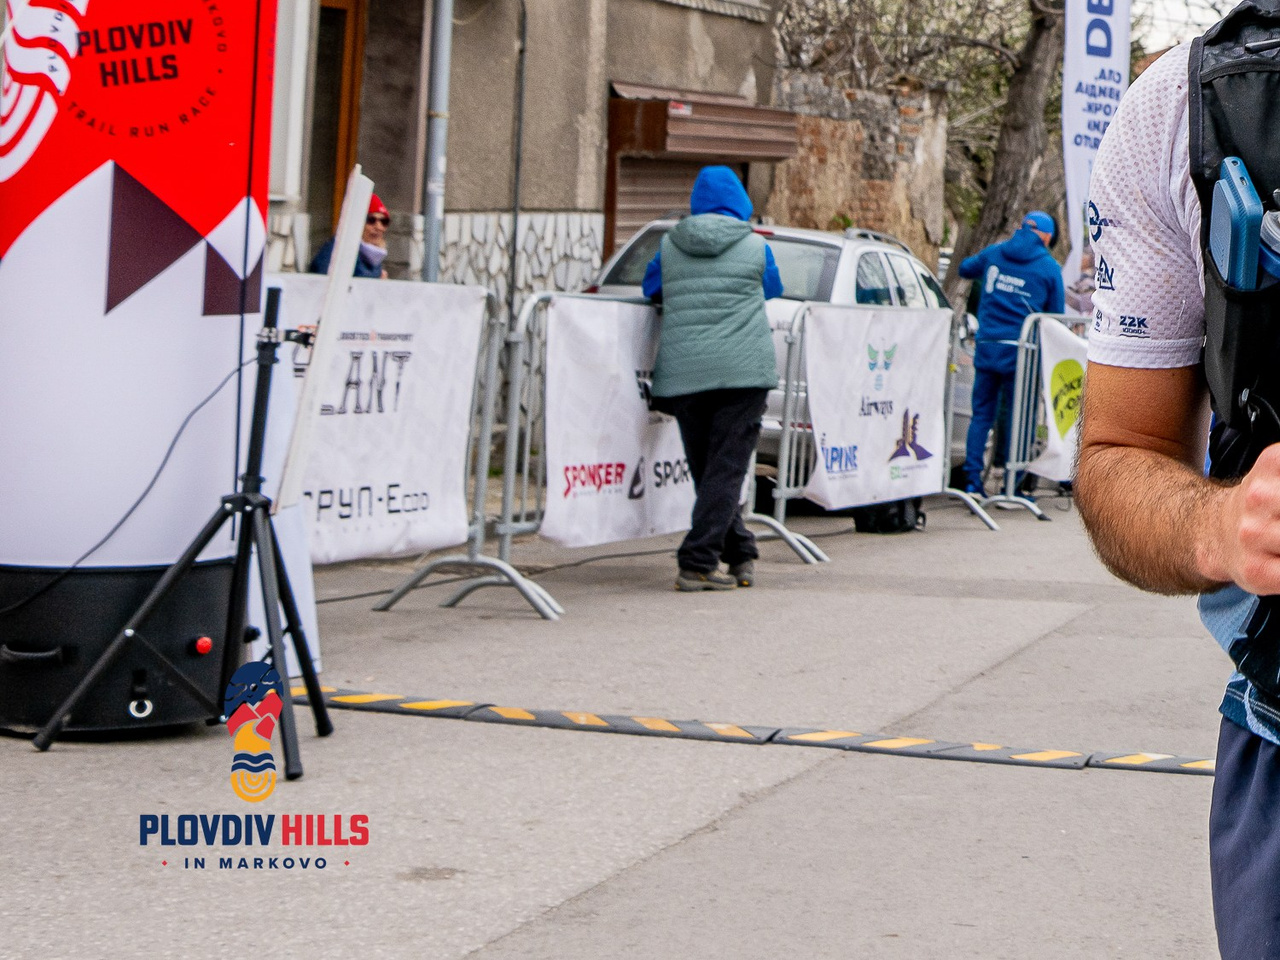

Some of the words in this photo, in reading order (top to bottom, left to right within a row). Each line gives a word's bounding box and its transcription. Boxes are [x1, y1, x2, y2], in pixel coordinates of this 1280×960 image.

[76, 18, 194, 57] PLOVDIV
[100, 54, 179, 88] HILLS
[67, 101, 117, 137] TRAIL
[130, 122, 171, 138] RUN
[653, 458, 692, 488] SPOR
